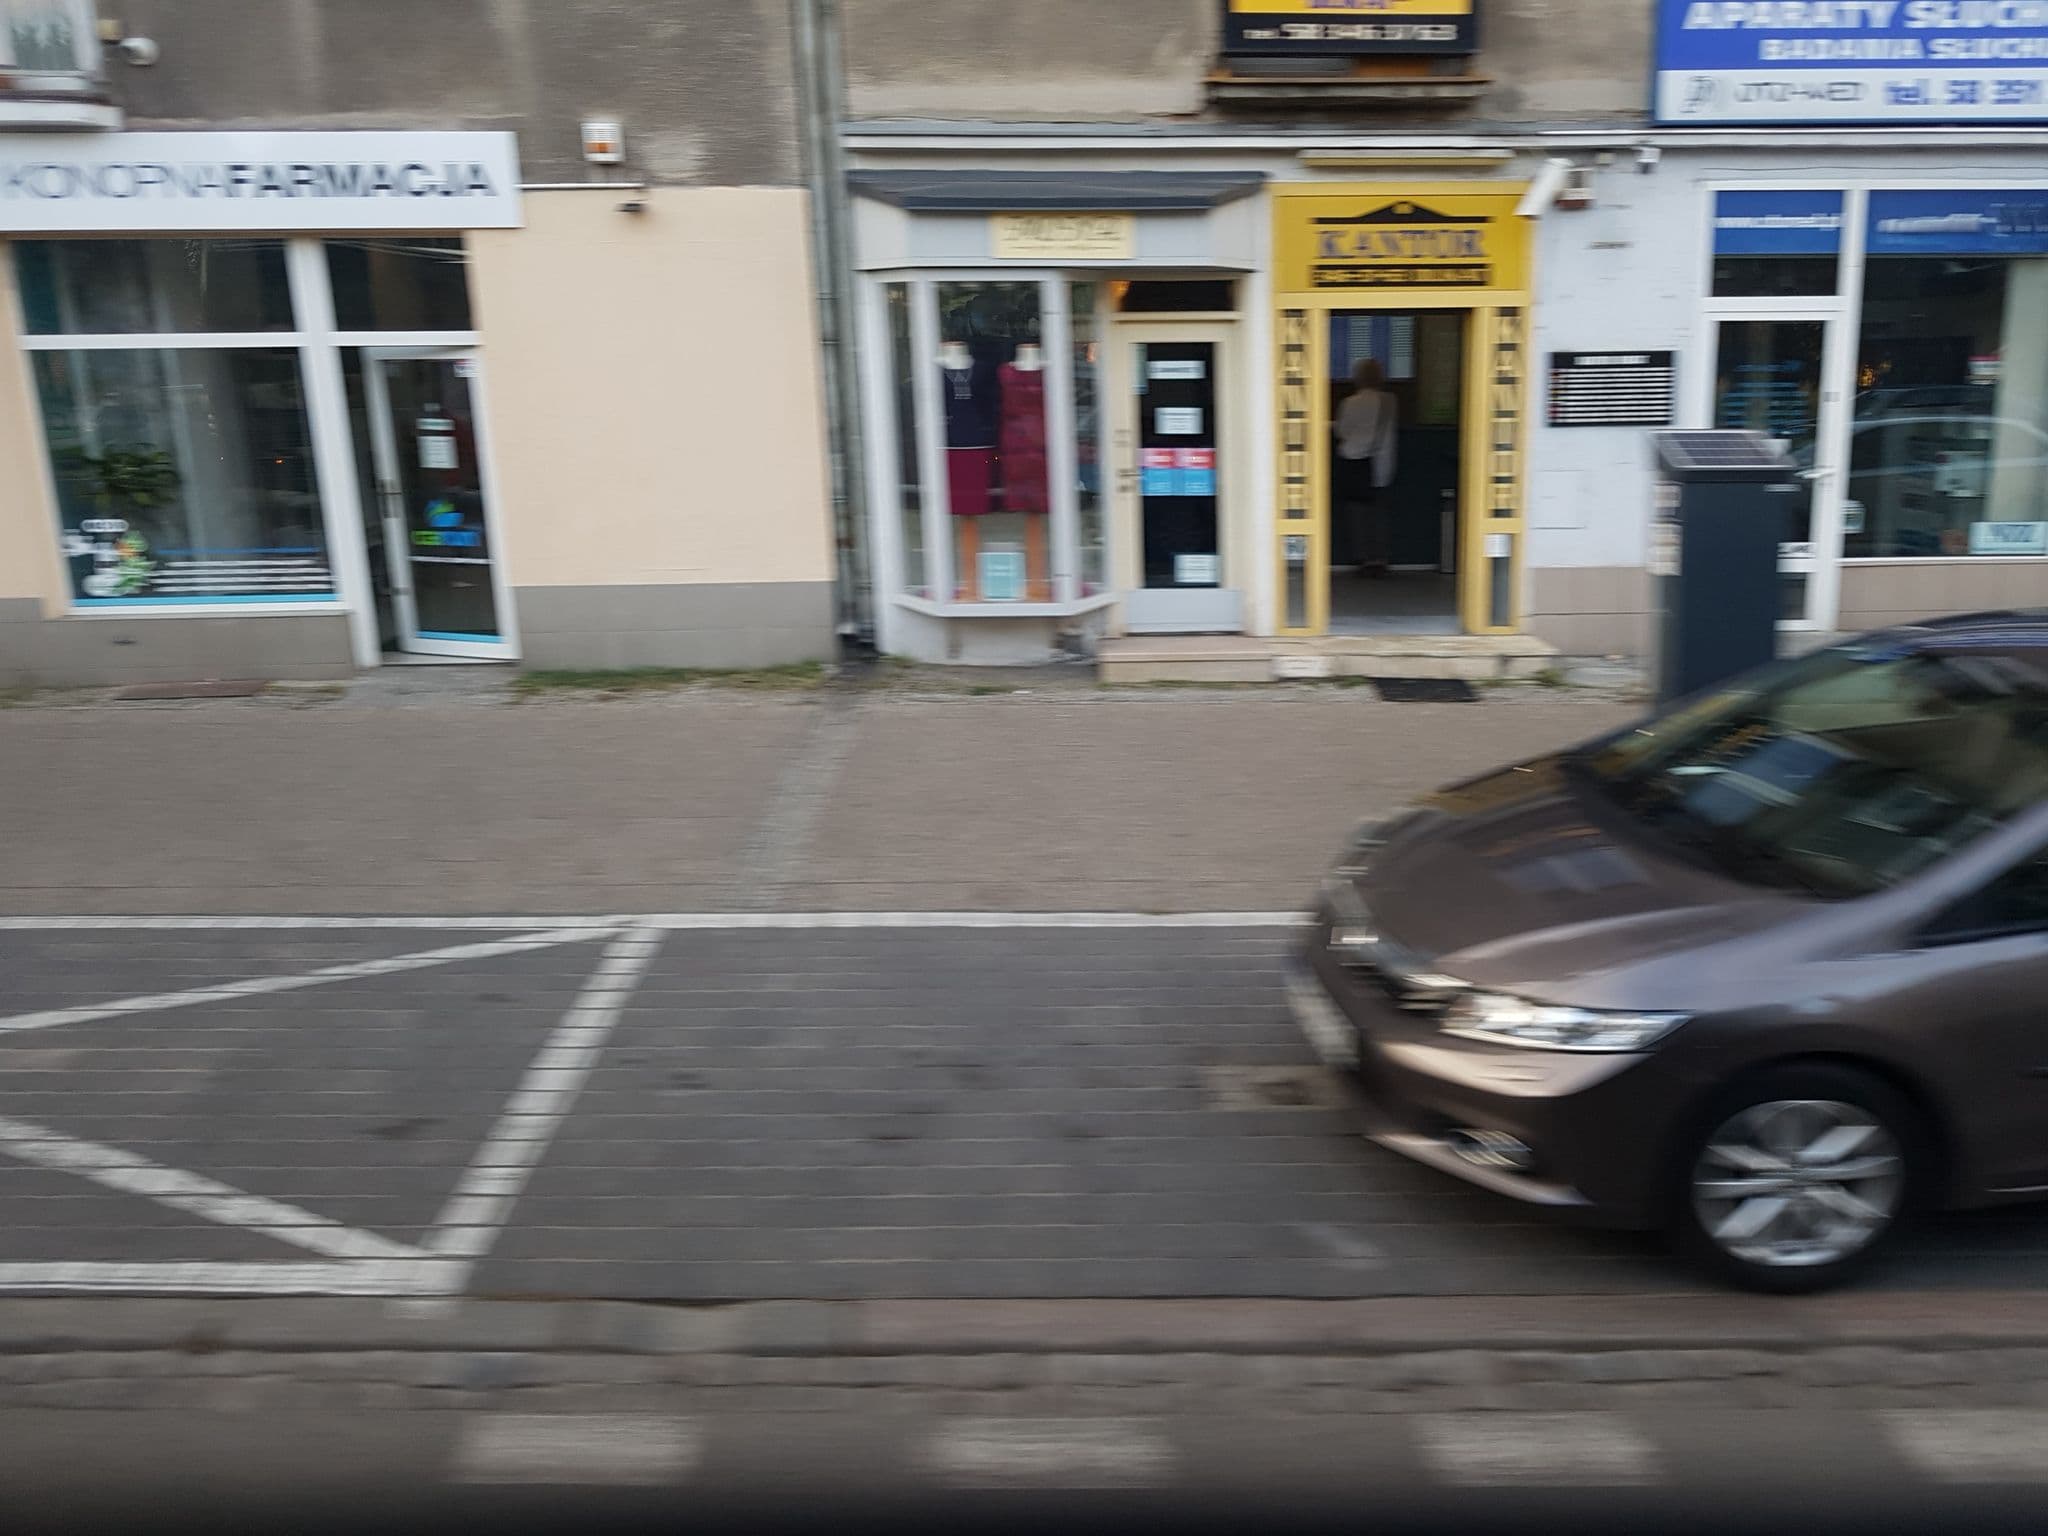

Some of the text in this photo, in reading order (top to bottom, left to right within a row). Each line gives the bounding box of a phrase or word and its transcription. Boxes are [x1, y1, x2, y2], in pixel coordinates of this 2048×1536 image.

[1682, 2, 1898, 29] APARATY
[1759, 39, 1924, 60] BADANIA
[1314, 229, 1487, 258] KANTOR
